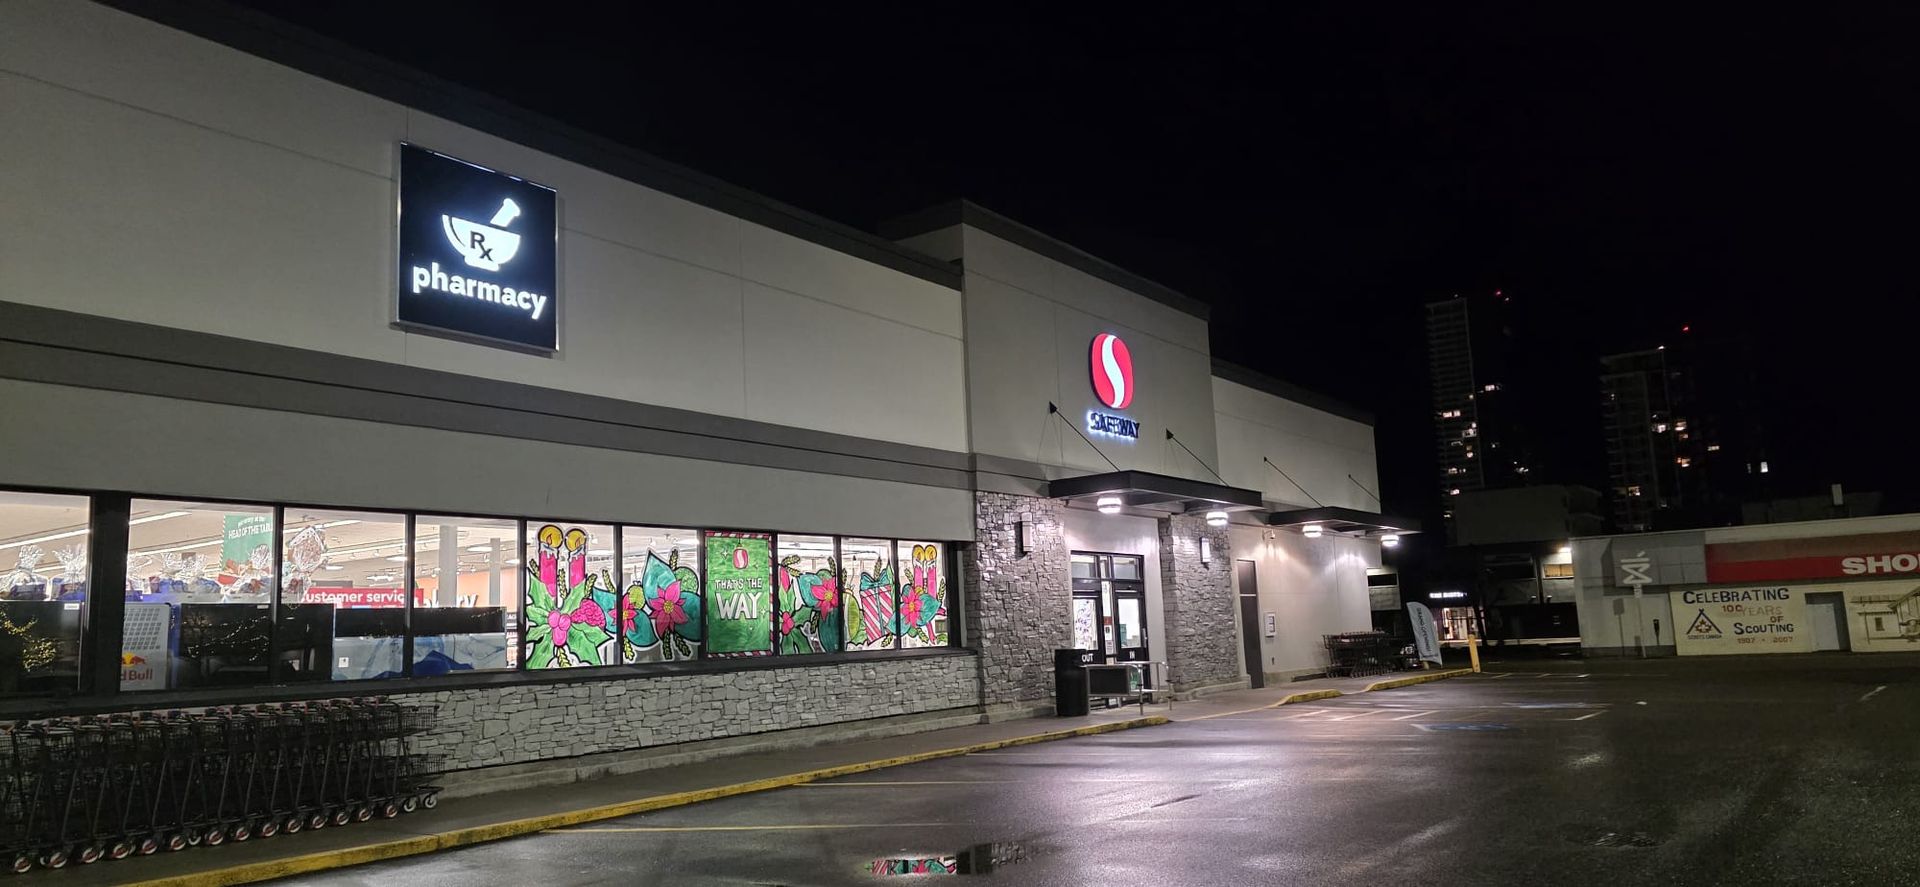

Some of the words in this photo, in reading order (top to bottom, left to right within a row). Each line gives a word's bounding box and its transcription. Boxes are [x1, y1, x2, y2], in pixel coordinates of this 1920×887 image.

[470, 231, 494, 262] Rx
[412, 262, 548, 320] pharmacy
[1089, 412, 1141, 439] SAFEWAY
[1842, 554, 1920, 575] SHO
[747, 577, 763, 590] THE
[305, 590, 362, 604] ustomer
[367, 589, 405, 604] servic
[1683, 587, 1790, 604] CELEBRATING
[715, 592, 763, 620] WAY
[1742, 605, 1783, 617] YEARS
[1770, 615, 1784, 623] OF
[1733, 622, 1794, 635] SCOUTING
[1081, 653, 1094, 663] OUT
[1129, 650, 1136, 660] IN
[128, 668, 153, 681] Bull
